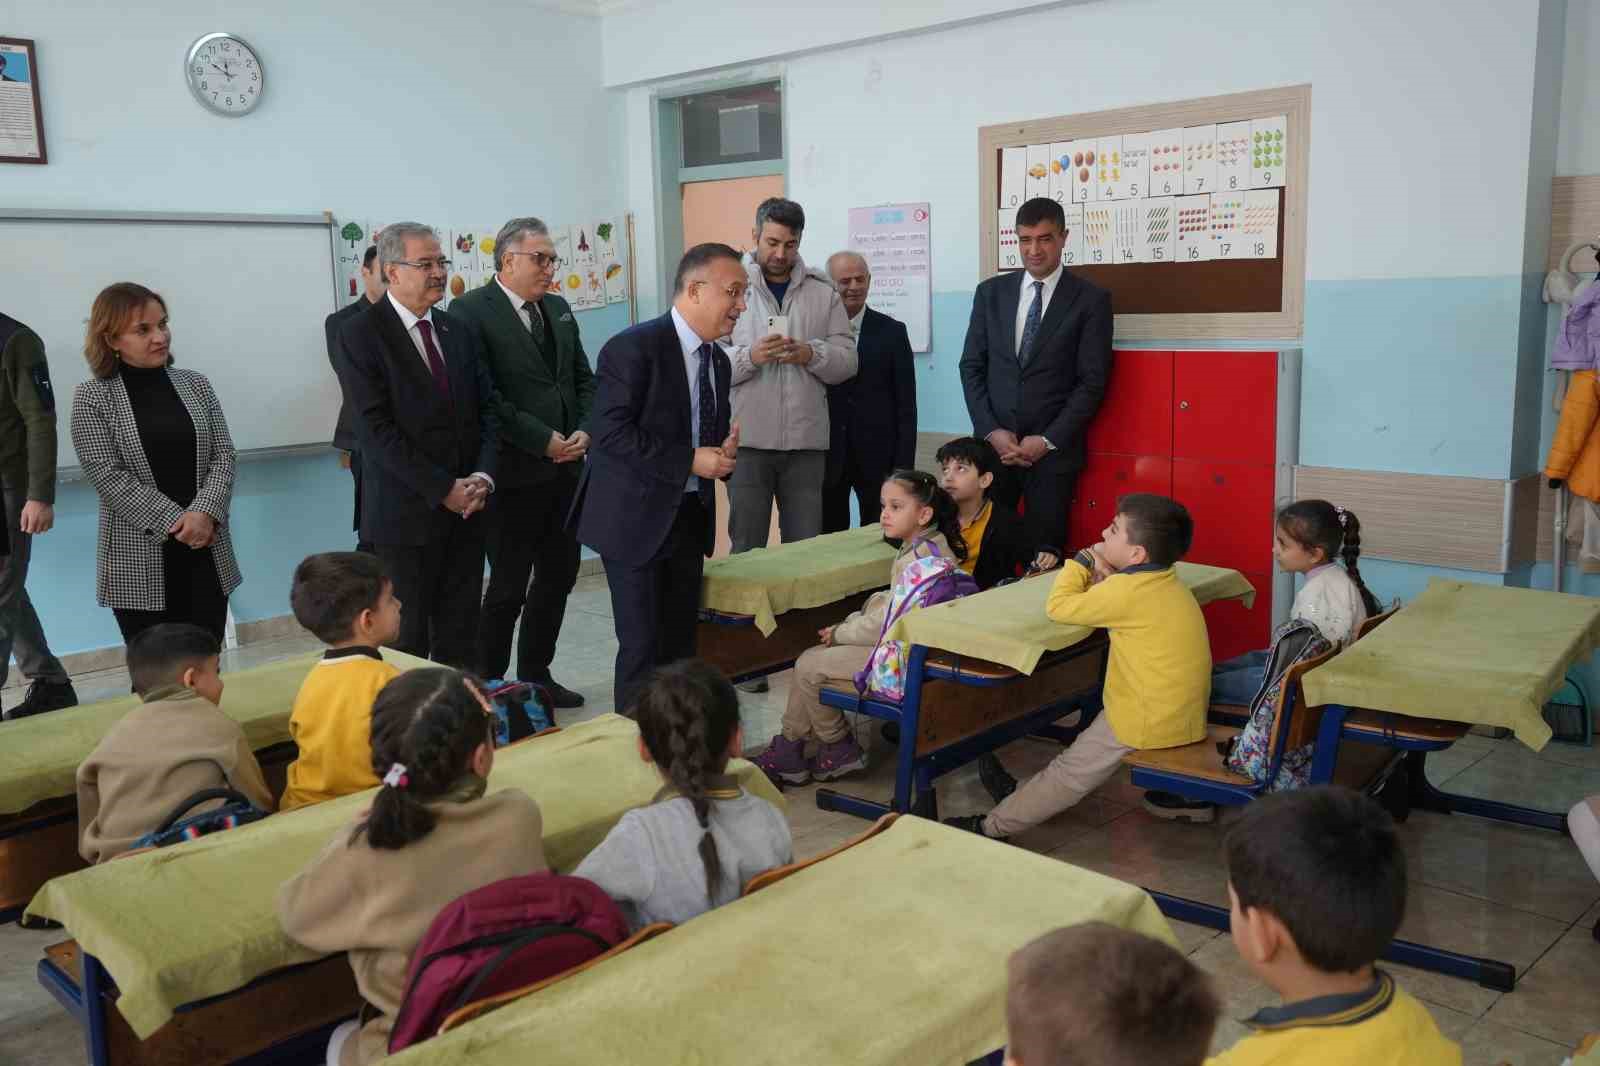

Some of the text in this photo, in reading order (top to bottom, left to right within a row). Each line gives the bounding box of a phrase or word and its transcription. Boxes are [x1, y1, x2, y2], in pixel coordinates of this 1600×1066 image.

[208, 46, 216, 56] 11
[220, 42, 230, 51] 12
[200, 55, 210, 64] 10
[246, 59, 253, 68] 2
[196, 66, 204, 76] 9
[251, 72, 257, 81] 3
[201, 81, 208, 90] 8
[225, 96, 233, 106] 6
[239, 94, 246, 104] 5
[1195, 178, 1204, 190] 7
[1229, 176, 1238, 189] 8
[1263, 172, 1272, 185] 9
[1105, 186, 1113, 198] 4
[1130, 183, 1138, 196] 5
[1163, 182, 1171, 193] 6
[1010, 194, 1018, 206] 0
[1056, 190, 1064, 203] 2
[1080, 188, 1088, 200] 3
[1121, 248, 1133, 261] 14
[1152, 247, 1163, 259] 15
[1188, 246, 1199, 259] 16
[1220, 243, 1231, 256] 17
[1253, 242, 1265, 256] 18
[1006, 255, 1016, 266] 10
[1063, 251, 1074, 264] 12
[1092, 249, 1103, 262] 13
